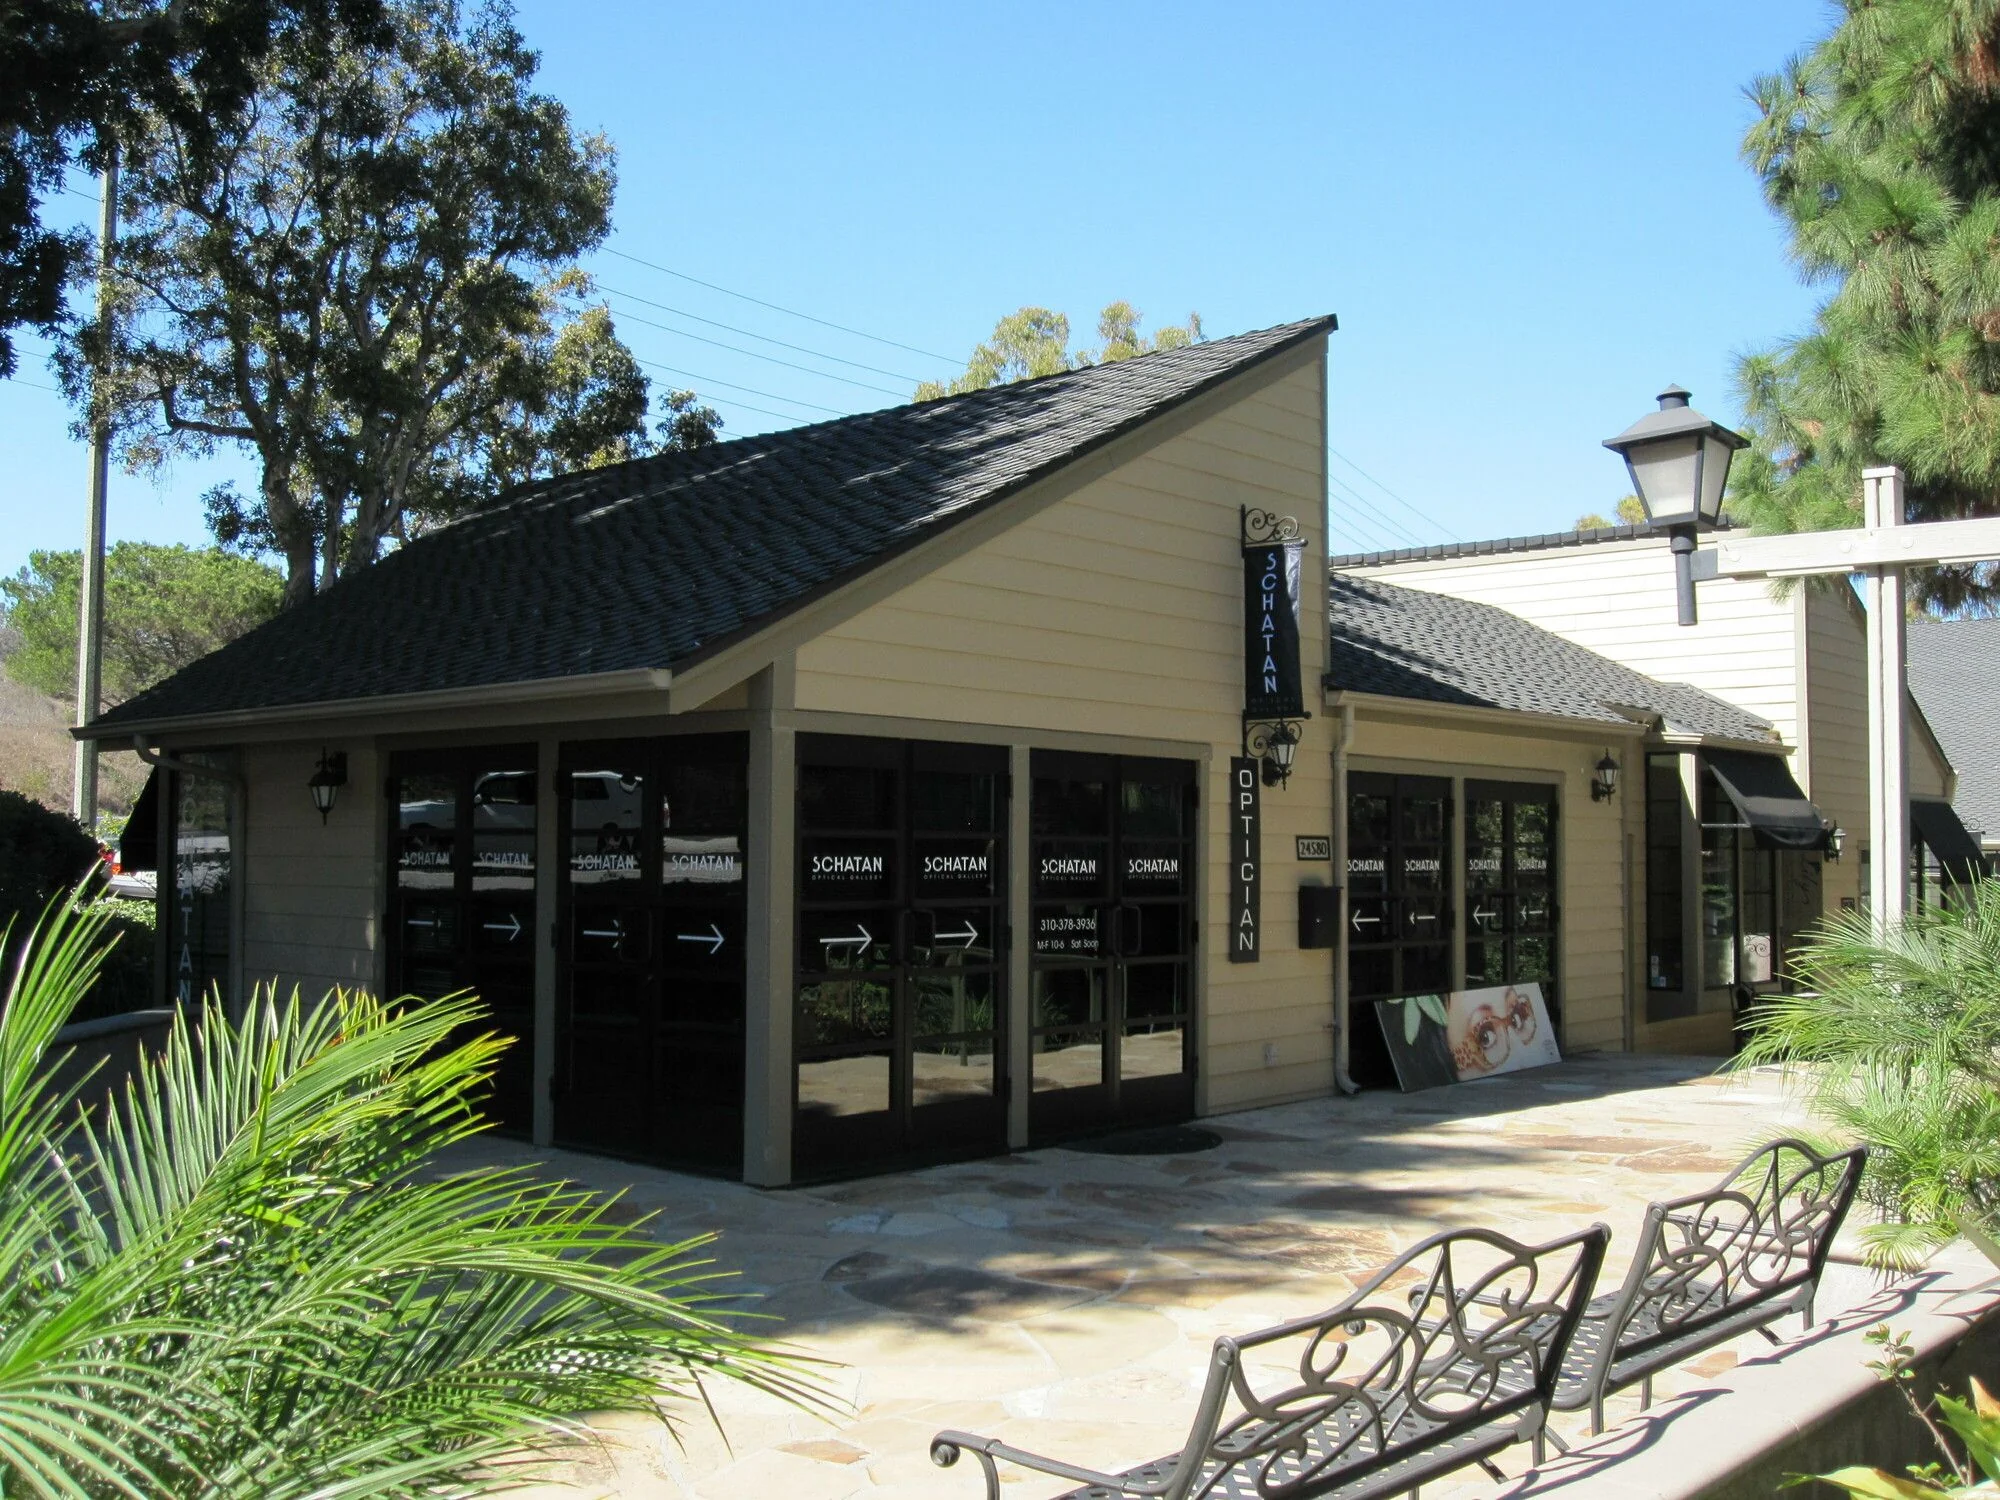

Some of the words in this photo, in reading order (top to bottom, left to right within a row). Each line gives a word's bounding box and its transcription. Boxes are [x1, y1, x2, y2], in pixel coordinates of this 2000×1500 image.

[1261, 552, 1277, 694] SCHATAN
[1300, 841, 1327, 855] 24580
[404, 852, 450, 865] SCHATAN
[479, 852, 529, 866] SCHATAN
[577, 854, 634, 870] SCHATAN
[671, 855, 734, 871] SCHATAN
[812, 856, 883, 872] SCHATAN
[924, 856, 987, 872] SCHATAN
[1239, 769, 1254, 951] OPTICIAN
[1347, 859, 1384, 872] SCHATAN
[1405, 859, 1440, 872] SCHATAN
[1469, 859, 1501, 870] SCHATAN
[1518, 859, 1547, 870] SCHATAN
[1041, 859, 1096, 873] SCHATAN
[1128, 859, 1178, 873] SCHATAN
[1040, 918, 1096, 931] 310-378-3936
